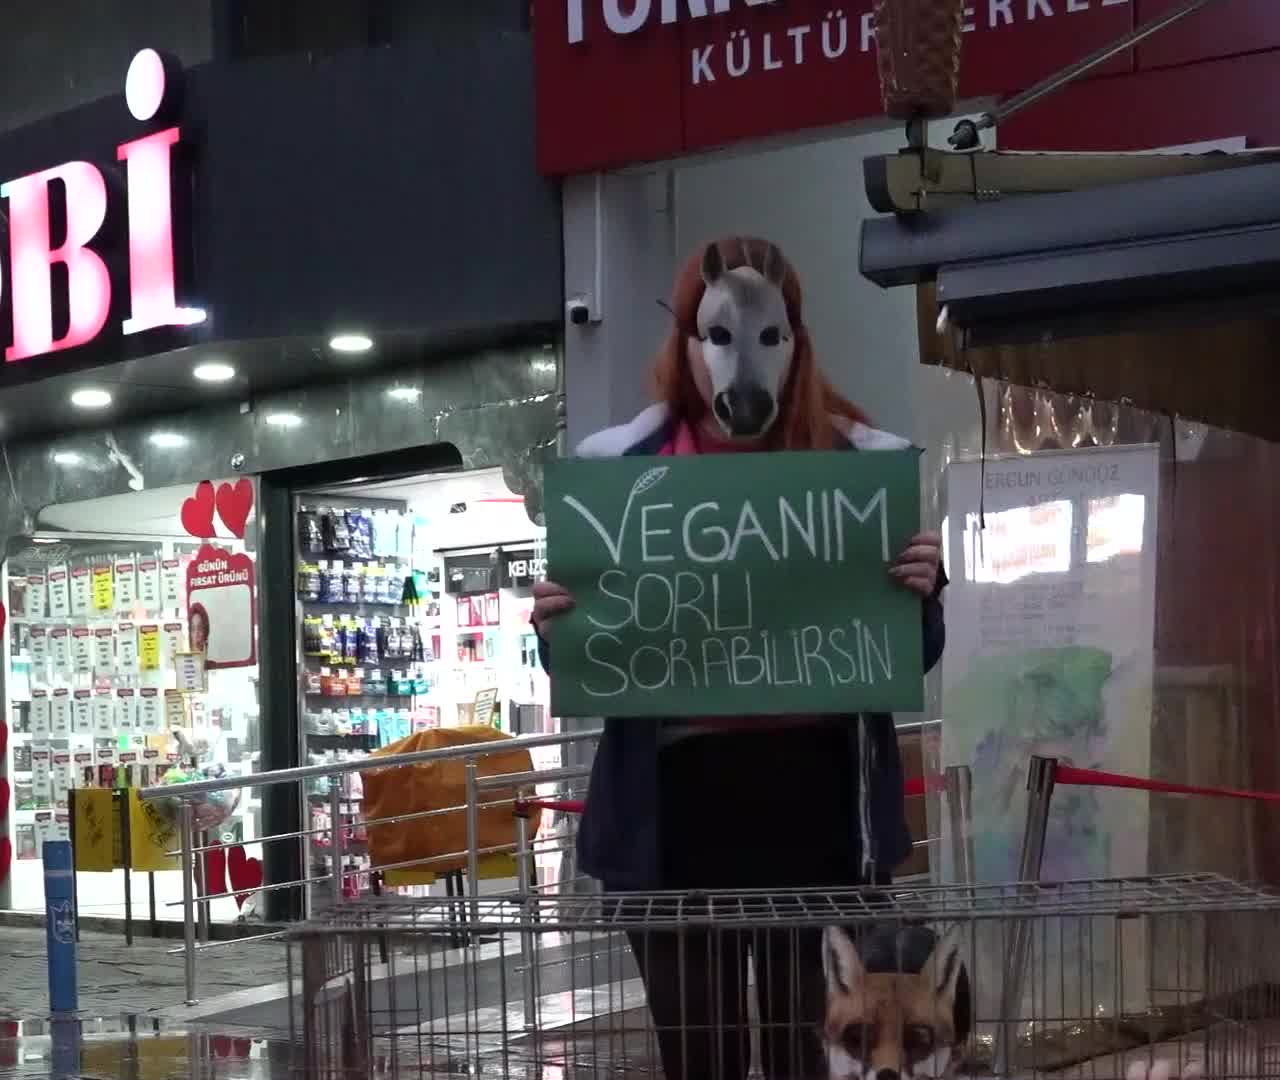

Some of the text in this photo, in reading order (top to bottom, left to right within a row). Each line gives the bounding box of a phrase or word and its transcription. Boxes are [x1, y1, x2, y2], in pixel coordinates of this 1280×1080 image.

[562, 486, 891, 565] VEGANIM
[198, 558, 228, 573] GÜNÜN
[218, 568, 249, 584] ÜRÜNÜ
[586, 569, 753, 633] SORU
[580, 616, 893, 698] SORABİLİRSİN
